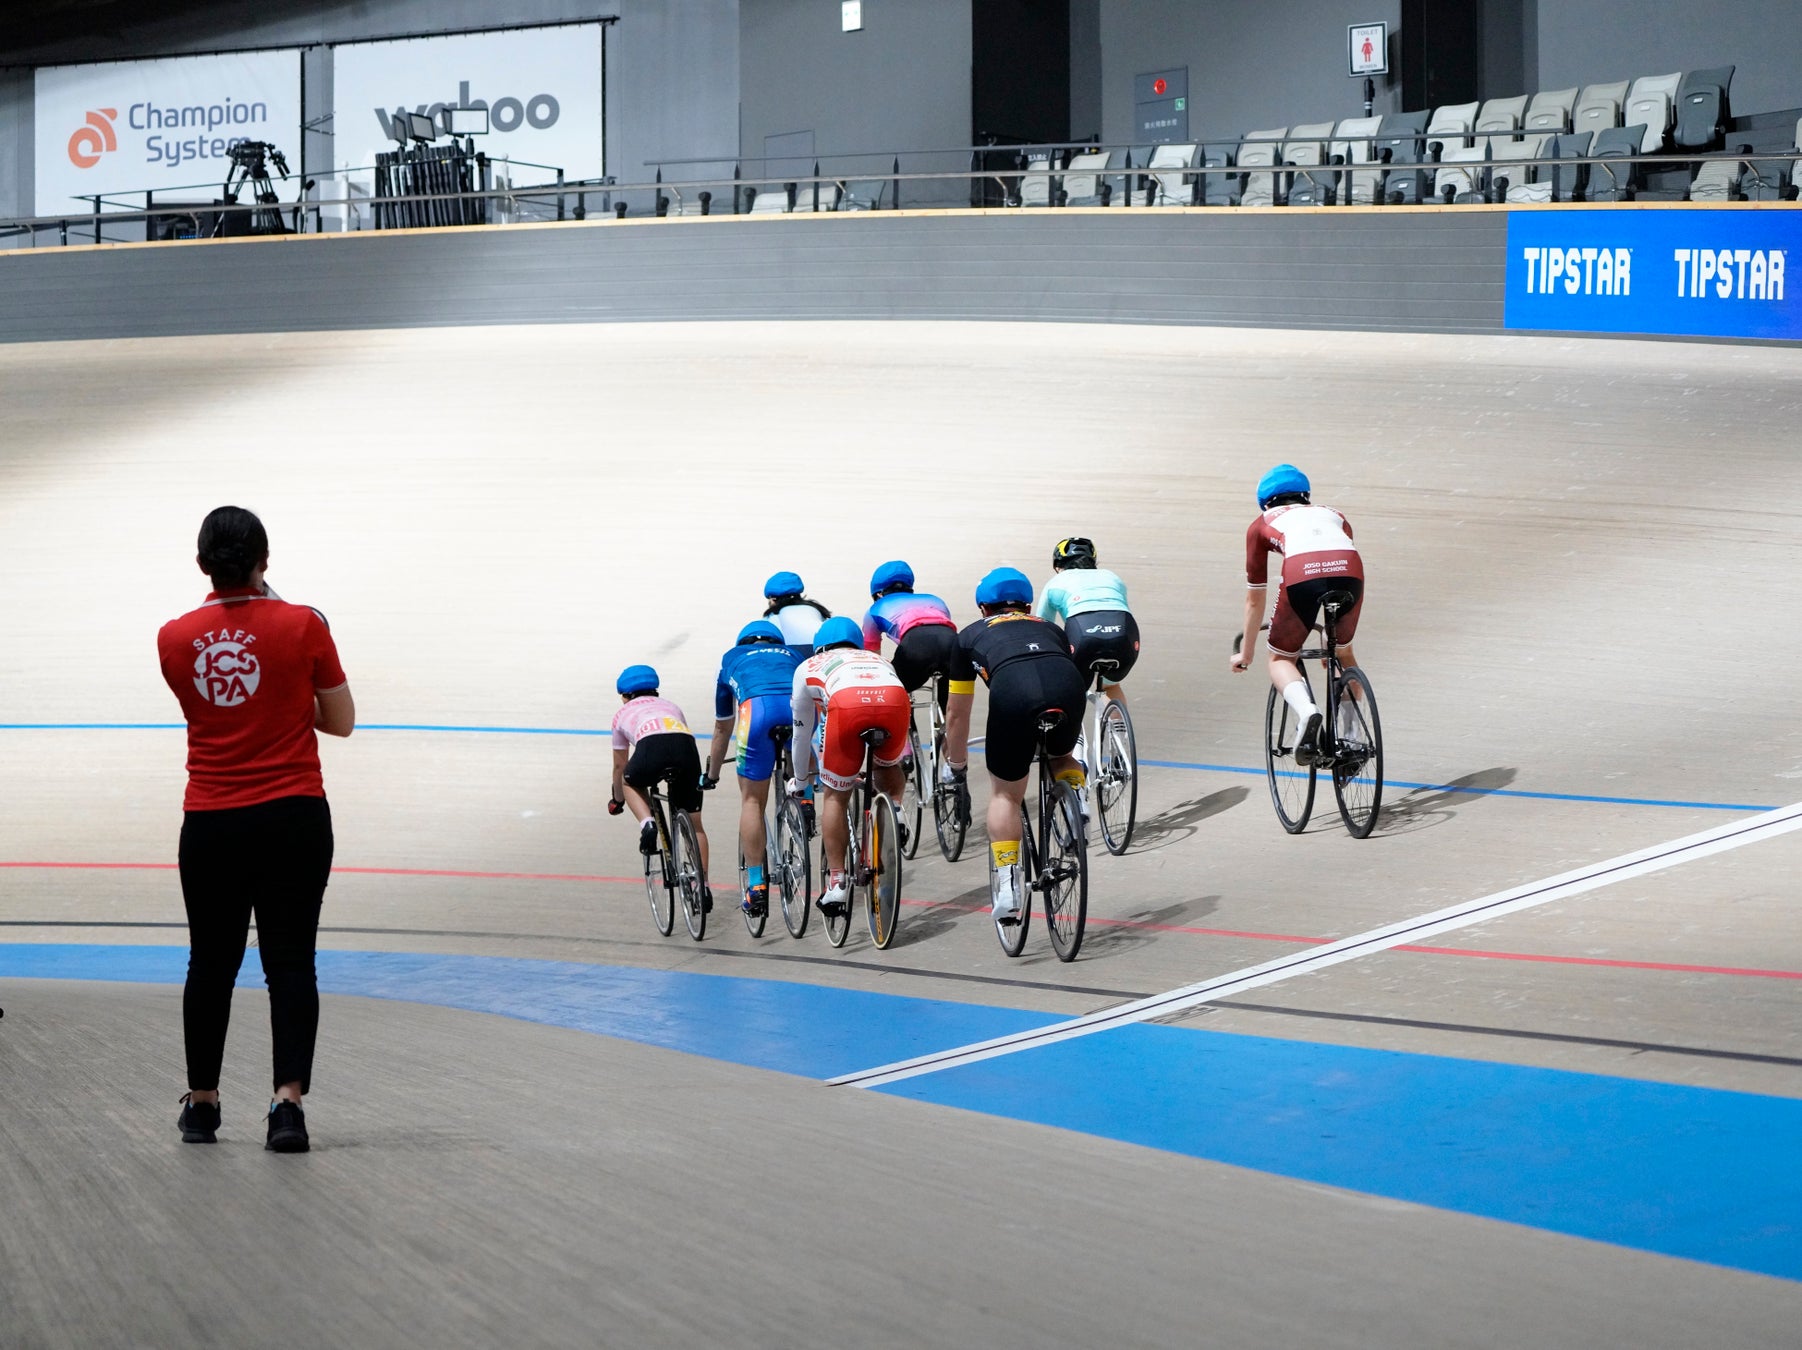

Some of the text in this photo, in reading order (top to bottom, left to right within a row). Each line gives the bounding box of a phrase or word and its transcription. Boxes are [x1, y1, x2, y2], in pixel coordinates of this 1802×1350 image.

[129, 97, 267, 132] Champion
[374, 81, 560, 140] wahoo
[1524, 247, 1632, 296] TIPSTAR
[1674, 249, 1786, 300] TIPSTAR
[193, 628, 257, 652] STAFF
[1101, 625, 1121, 633] JPF
